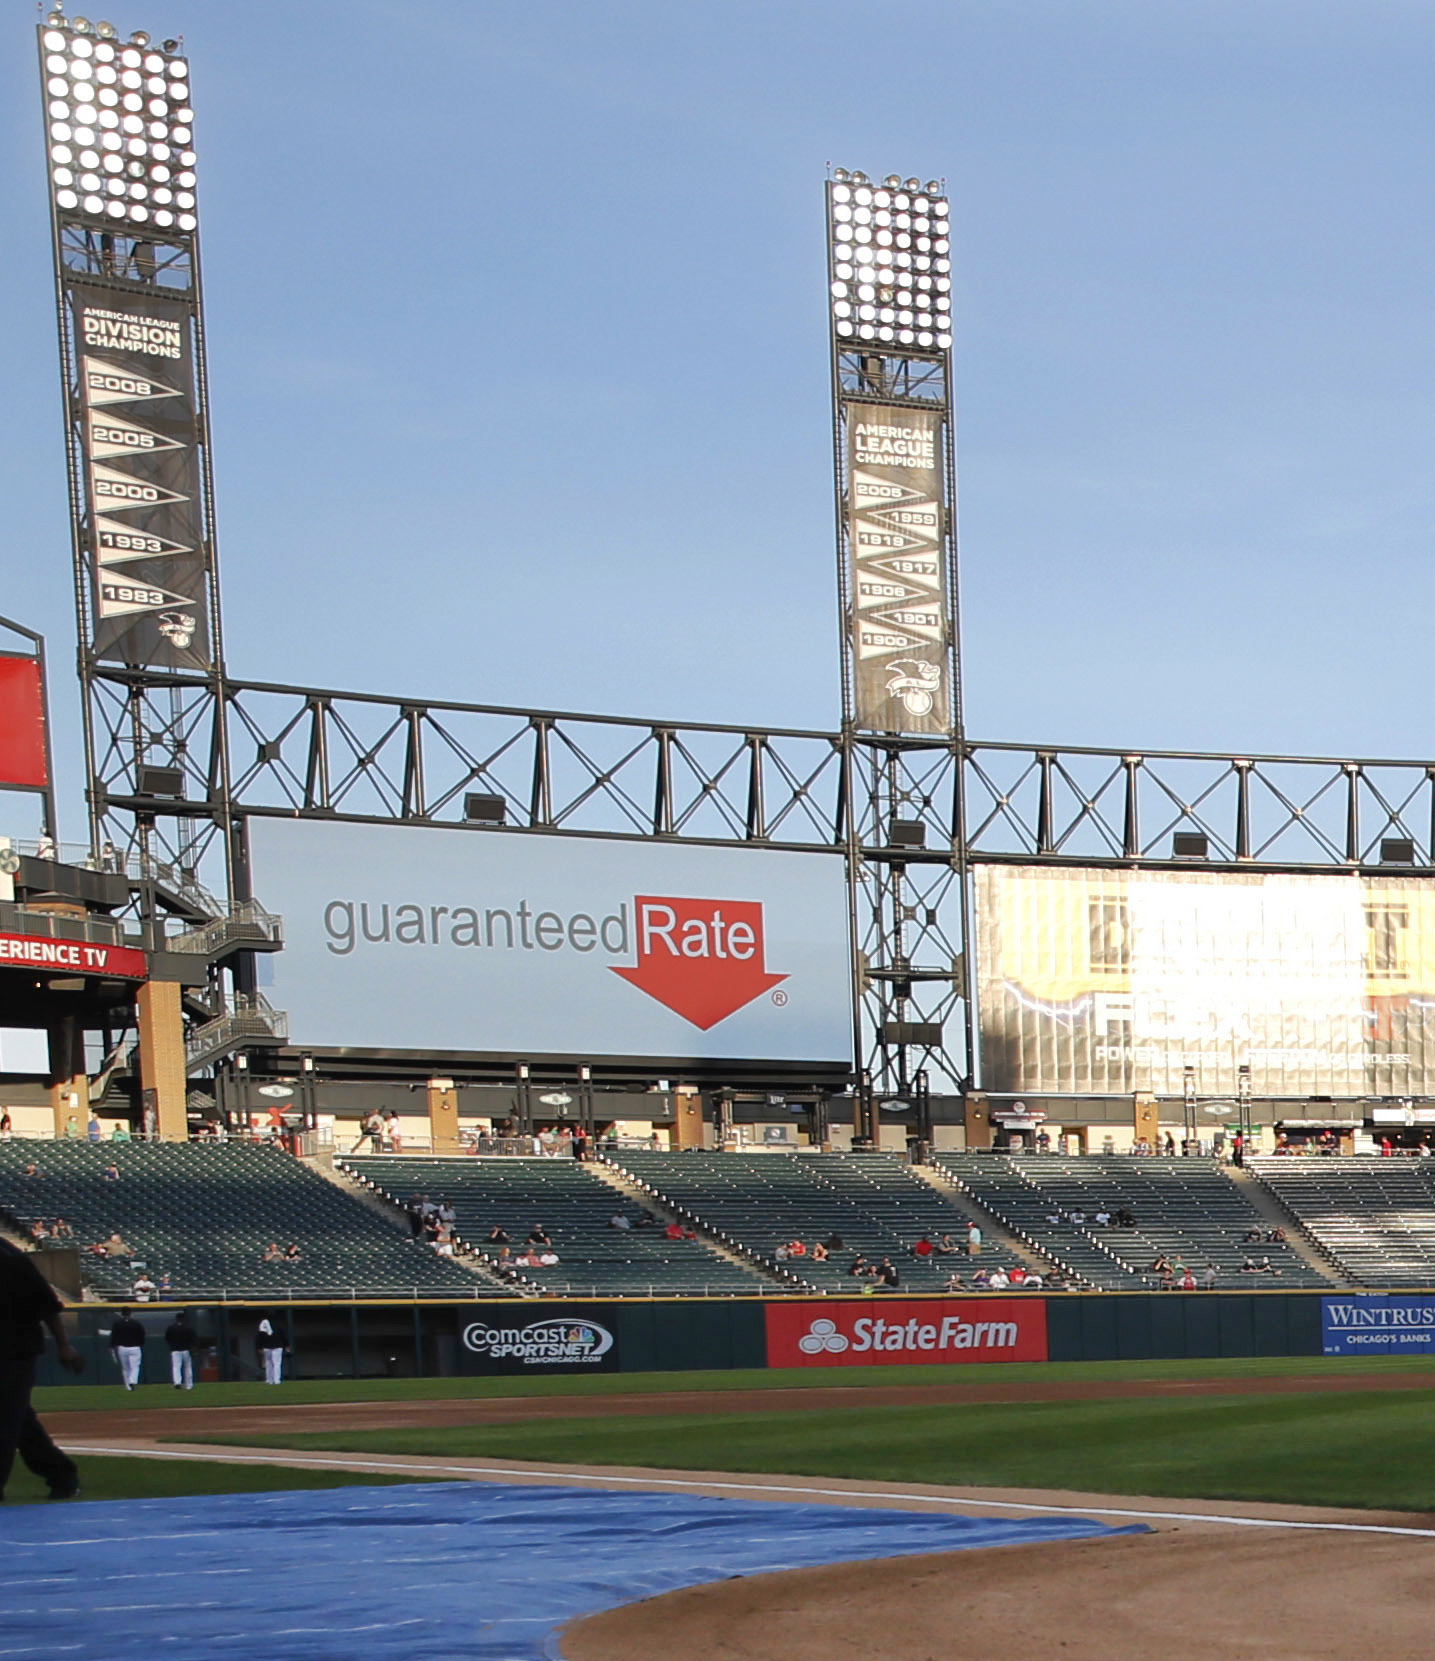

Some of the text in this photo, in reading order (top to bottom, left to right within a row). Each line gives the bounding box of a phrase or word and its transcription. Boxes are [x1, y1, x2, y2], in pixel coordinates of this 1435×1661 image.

[83, 307, 180, 331] AMERICAN LEAGUE
[84, 316, 180, 347] DIVISION
[85, 333, 181, 359] CHAMPIONS
[90, 374, 151, 396] 2008
[92, 427, 155, 449] 2005
[855, 423, 934, 442] AMERICAN
[855, 435, 934, 458] LEAGUE
[855, 451, 935, 470] CHAMPIONS
[96, 481, 158, 502] 2000
[856, 484, 903, 499] 2005
[890, 511, 935, 525] 1959
[100, 533, 162, 554] 1993
[858, 532, 905, 547] 1919
[891, 560, 936, 575] 1917
[103, 587, 164, 607] 1983
[893, 612, 938, 626] 1901
[863, 635, 908, 649] 1900
[323, 898, 756, 960] guaranteed Rate
[84, 948, 108, 967] TV
[1346, 1334, 1431, 1344] CHICAGO'S BANKS
[490, 1343, 595, 1357] SPORTSNET
